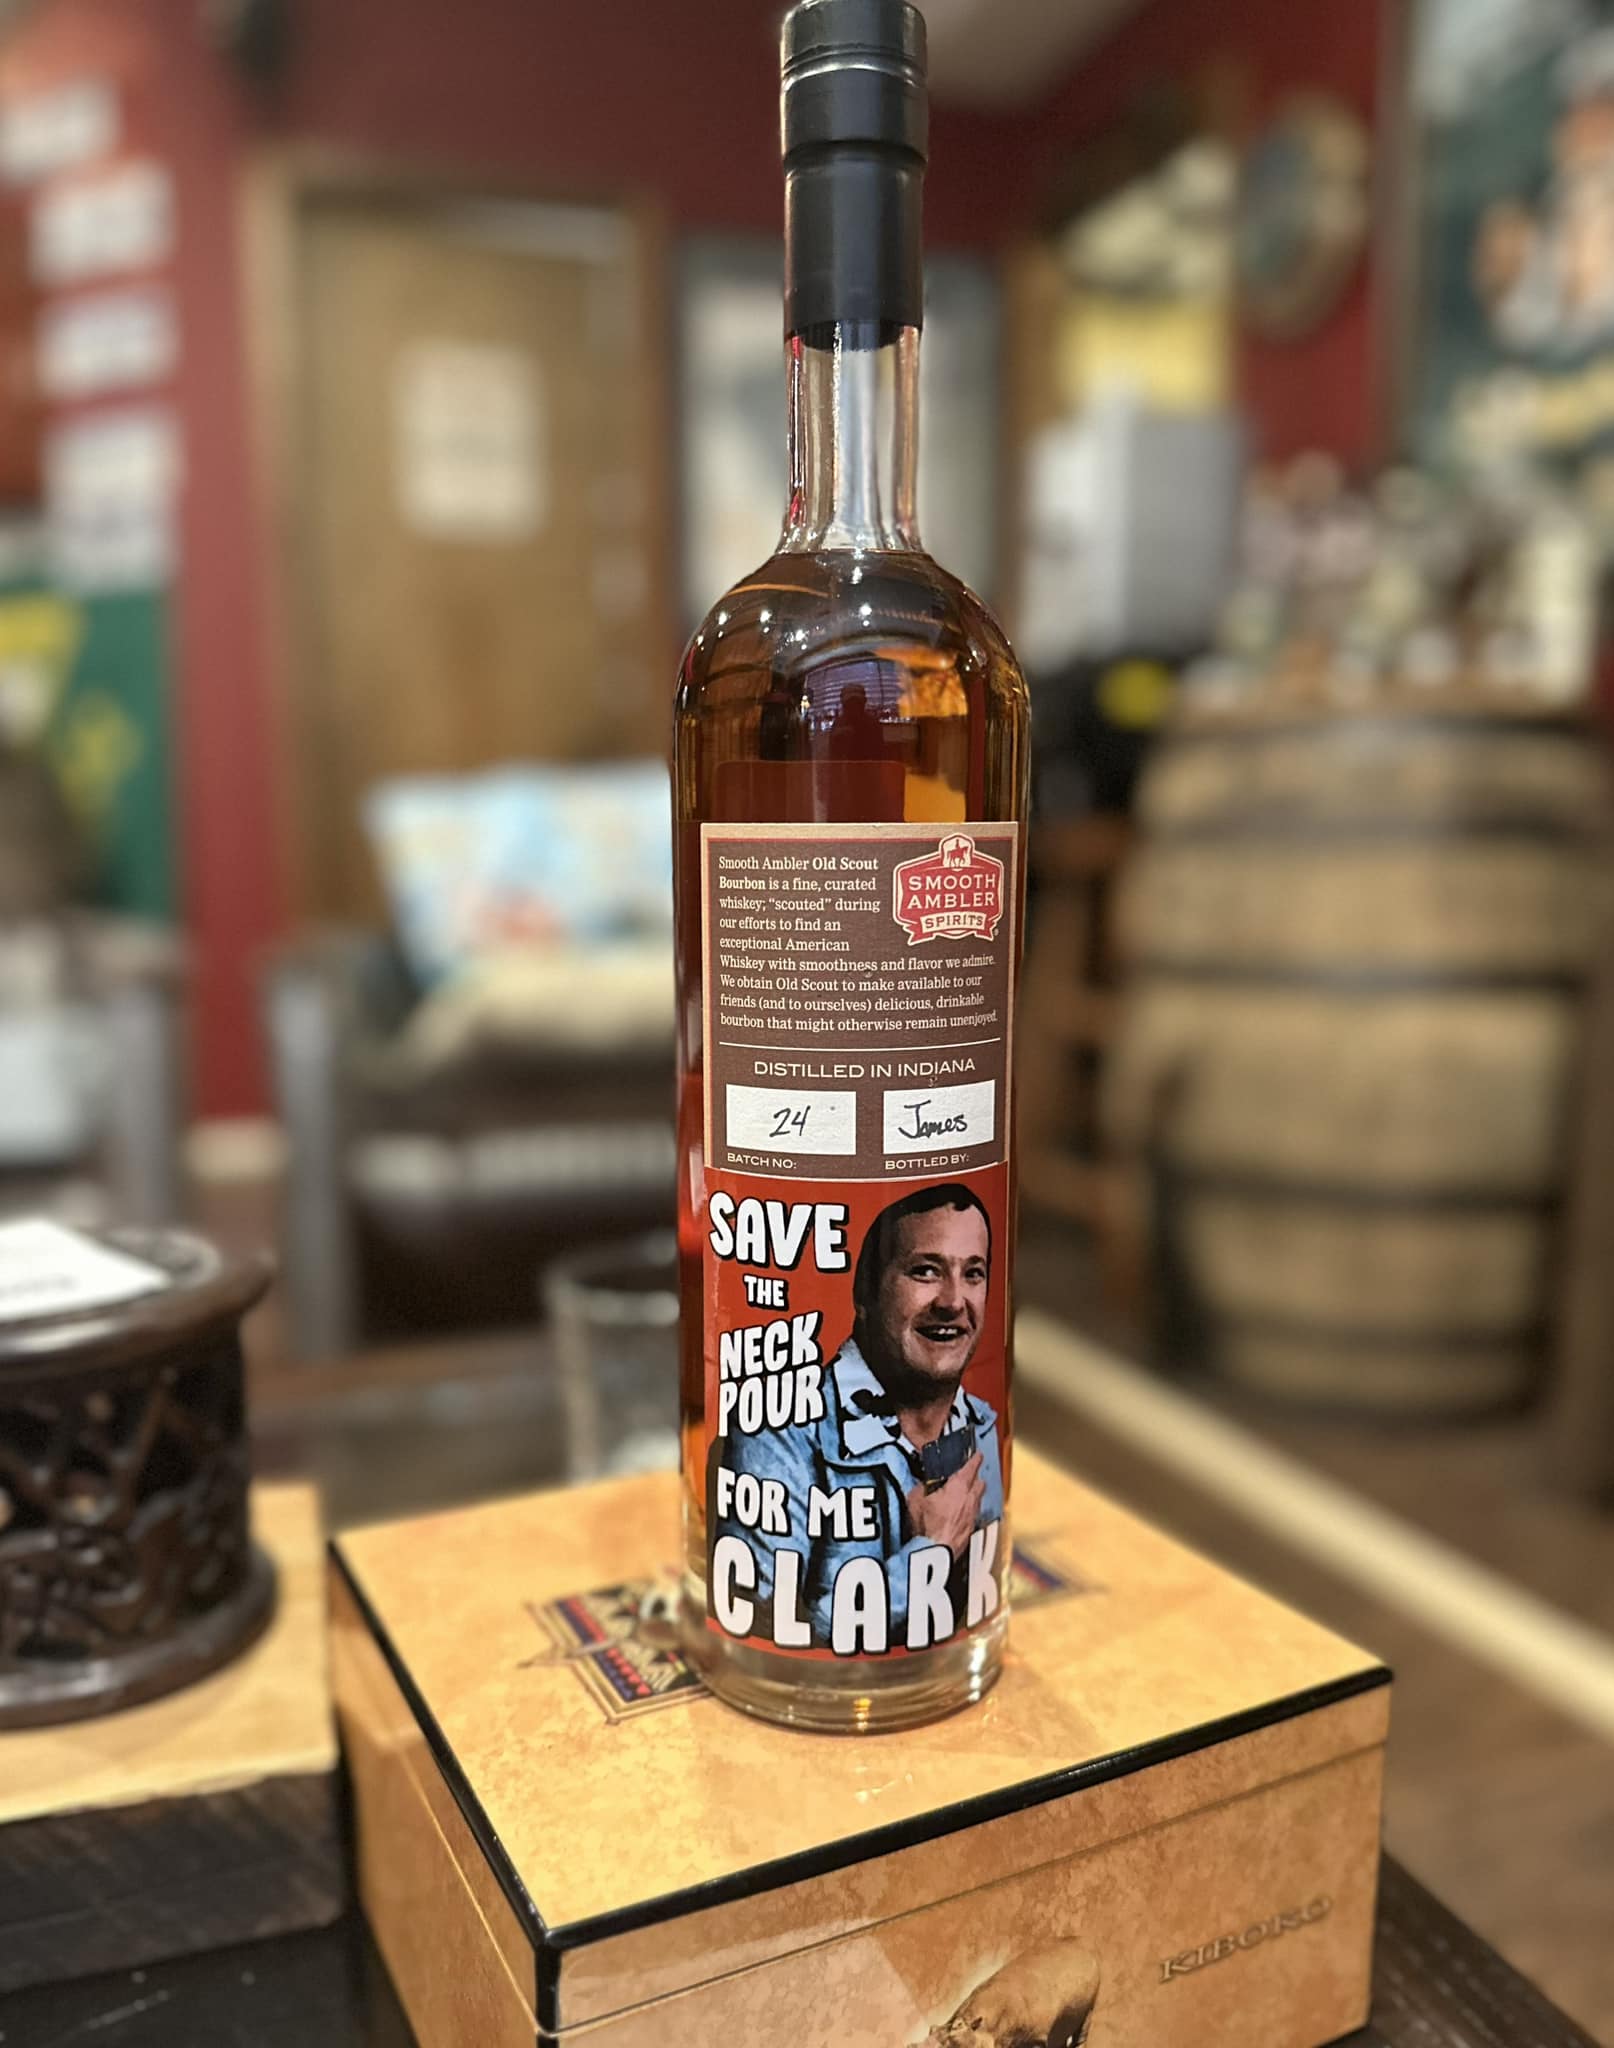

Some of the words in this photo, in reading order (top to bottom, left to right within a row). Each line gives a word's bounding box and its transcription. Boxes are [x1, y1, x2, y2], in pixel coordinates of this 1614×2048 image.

[719, 856, 758, 870] Smooth
[762, 857, 809, 870] Ambler
[812, 858, 835, 870] Old
[840, 858, 878, 870] Scout
[719, 876, 765, 889] Bourbon
[769, 877, 779, 889] is
[782, 881, 789, 890] a
[793, 877, 821, 892] fine,
[825, 878, 876, 890] curated
[909, 874, 995, 891] SMOOTH
[835, 898, 880, 913] during
[907, 892, 994, 909] AMBLER
[720, 919, 737, 928] our
[739, 917, 776, 930] efforts
[780, 920, 792, 930] to
[795, 918, 820, 931] find
[824, 921, 840, 931] an
[925, 914, 983, 929] SPIRITS
[720, 937, 781, 950] exceptional
[785, 938, 849, 951] American
[720, 955, 765, 972] Whiskey
[768, 957, 796, 970] with
[799, 958, 878, 972] smoothness
[881, 957, 904, 971] and
[908, 957, 943, 970] flavor
[946, 958, 960, 968] we
[720, 975, 735, 987] We
[737, 976, 773, 989] obtain
[776, 978, 799, 991] Old
[801, 978, 838, 992] Scout
[842, 980, 855, 992] to
[859, 978, 894, 992] make
[897, 977, 951, 991] available
[954, 977, 963, 987] to
[966, 975, 982, 986] our
[720, 993, 756, 1008] friends
[759, 997, 785, 1011] (and
[789, 999, 801, 1011] to
[804, 998, 871, 1013] ourselves)
[875, 996, 933, 1013] delicious,
[937, 993, 984, 1009] drinkable
[721, 1013, 764, 1028] bourbon
[767, 1016, 792, 1030] that
[795, 1017, 835, 1033] might
[838, 1017, 903, 1031] otherwise
[905, 1016, 947, 1029] remain
[755, 1062, 864, 1078] DISTILLED
[871, 1063, 892, 1078] IN
[898, 1058, 975, 1077] INDIANA
[769, 1106, 811, 1137] 24
[898, 1099, 968, 1139] James
[727, 1153, 769, 1168] BATCH
[772, 1158, 796, 1169] NO:
[885, 1156, 948, 1170] BOTTLED
[950, 1154, 969, 1165] BY:
[709, 1192, 848, 1268] SAVE
[744, 1275, 785, 1306] THE
[720, 1312, 818, 1380] NECK
[719, 1365, 824, 1436] POUR
[717, 1468, 787, 1532] FOR
[808, 1487, 875, 1538] ME
[713, 1518, 999, 1654] CLARK
[1159, 1895, 1333, 1984] KIBOKO
